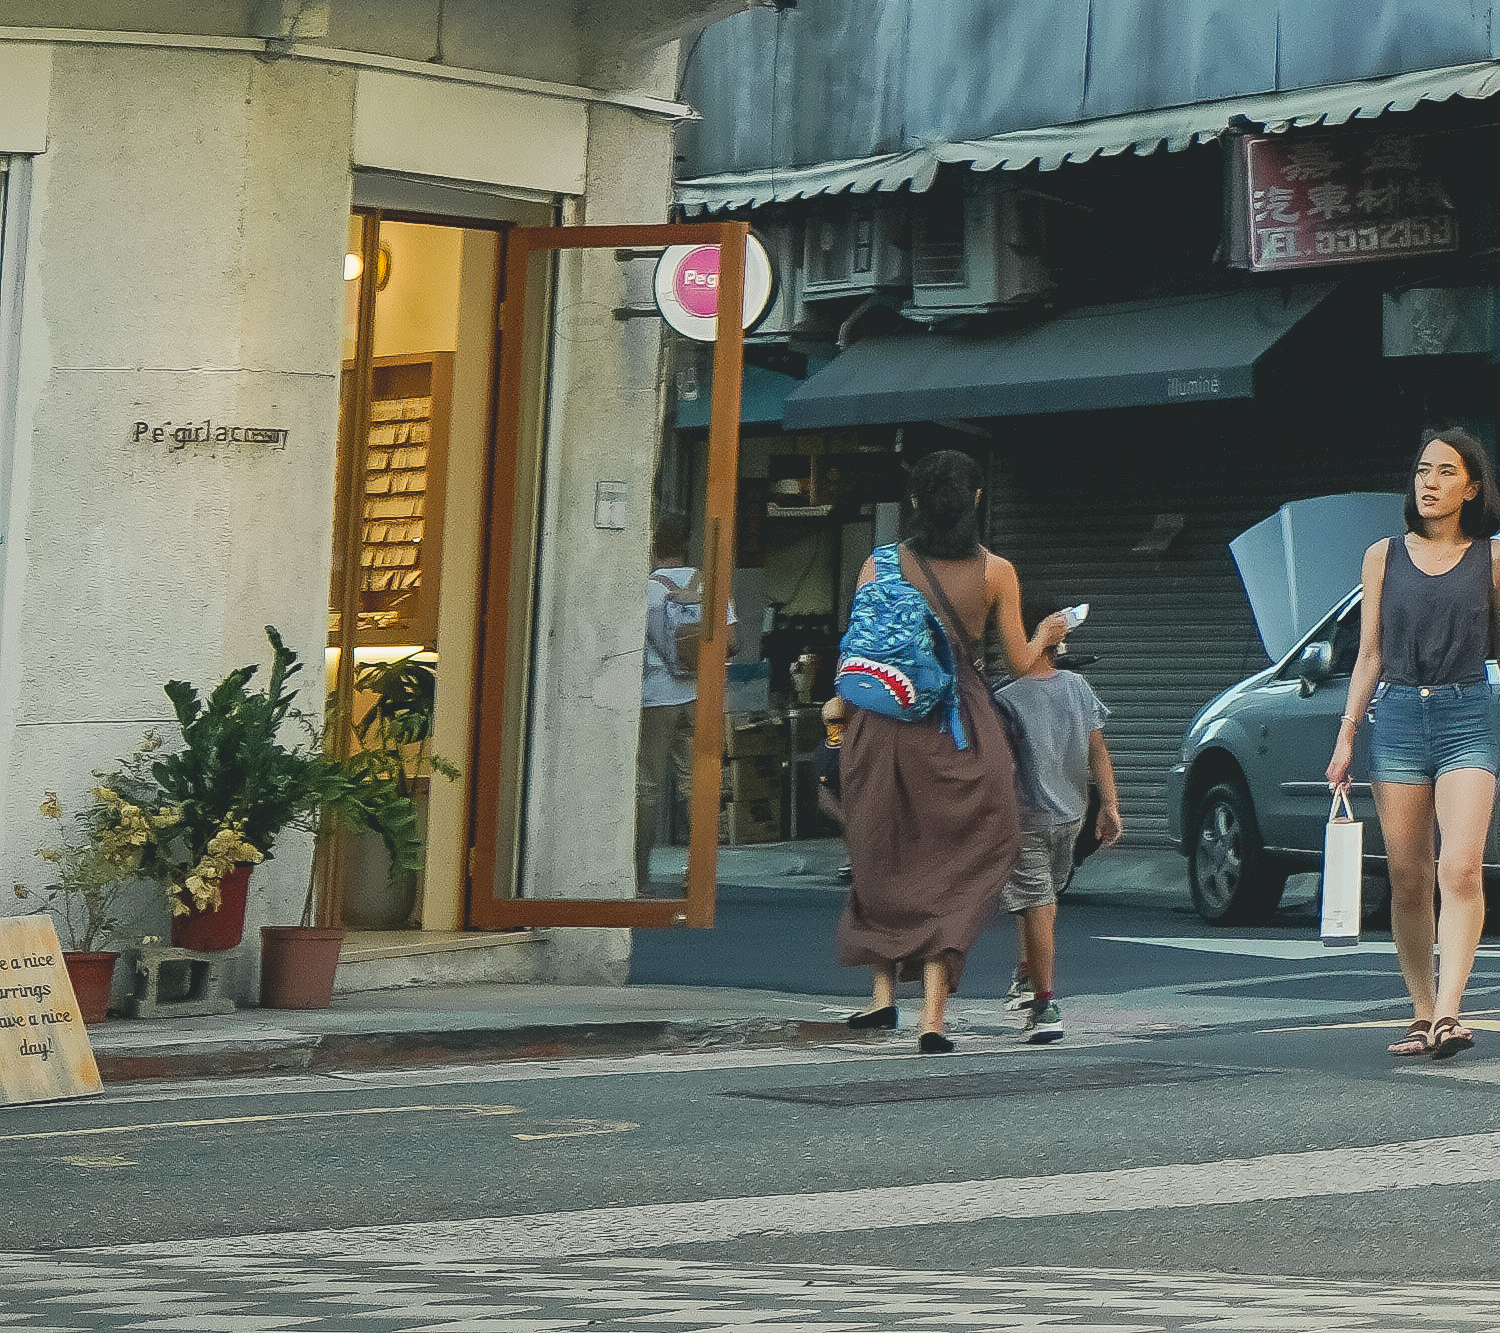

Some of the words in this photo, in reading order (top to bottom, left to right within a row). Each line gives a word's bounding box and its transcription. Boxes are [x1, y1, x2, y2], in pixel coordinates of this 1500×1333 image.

[24, 953, 54, 968] nice
[0, 984, 51, 1003] arrings
[0, 1015, 26, 1028] ave
[41, 1010, 72, 1023] nice
[19, 1039, 54, 1061] day!
